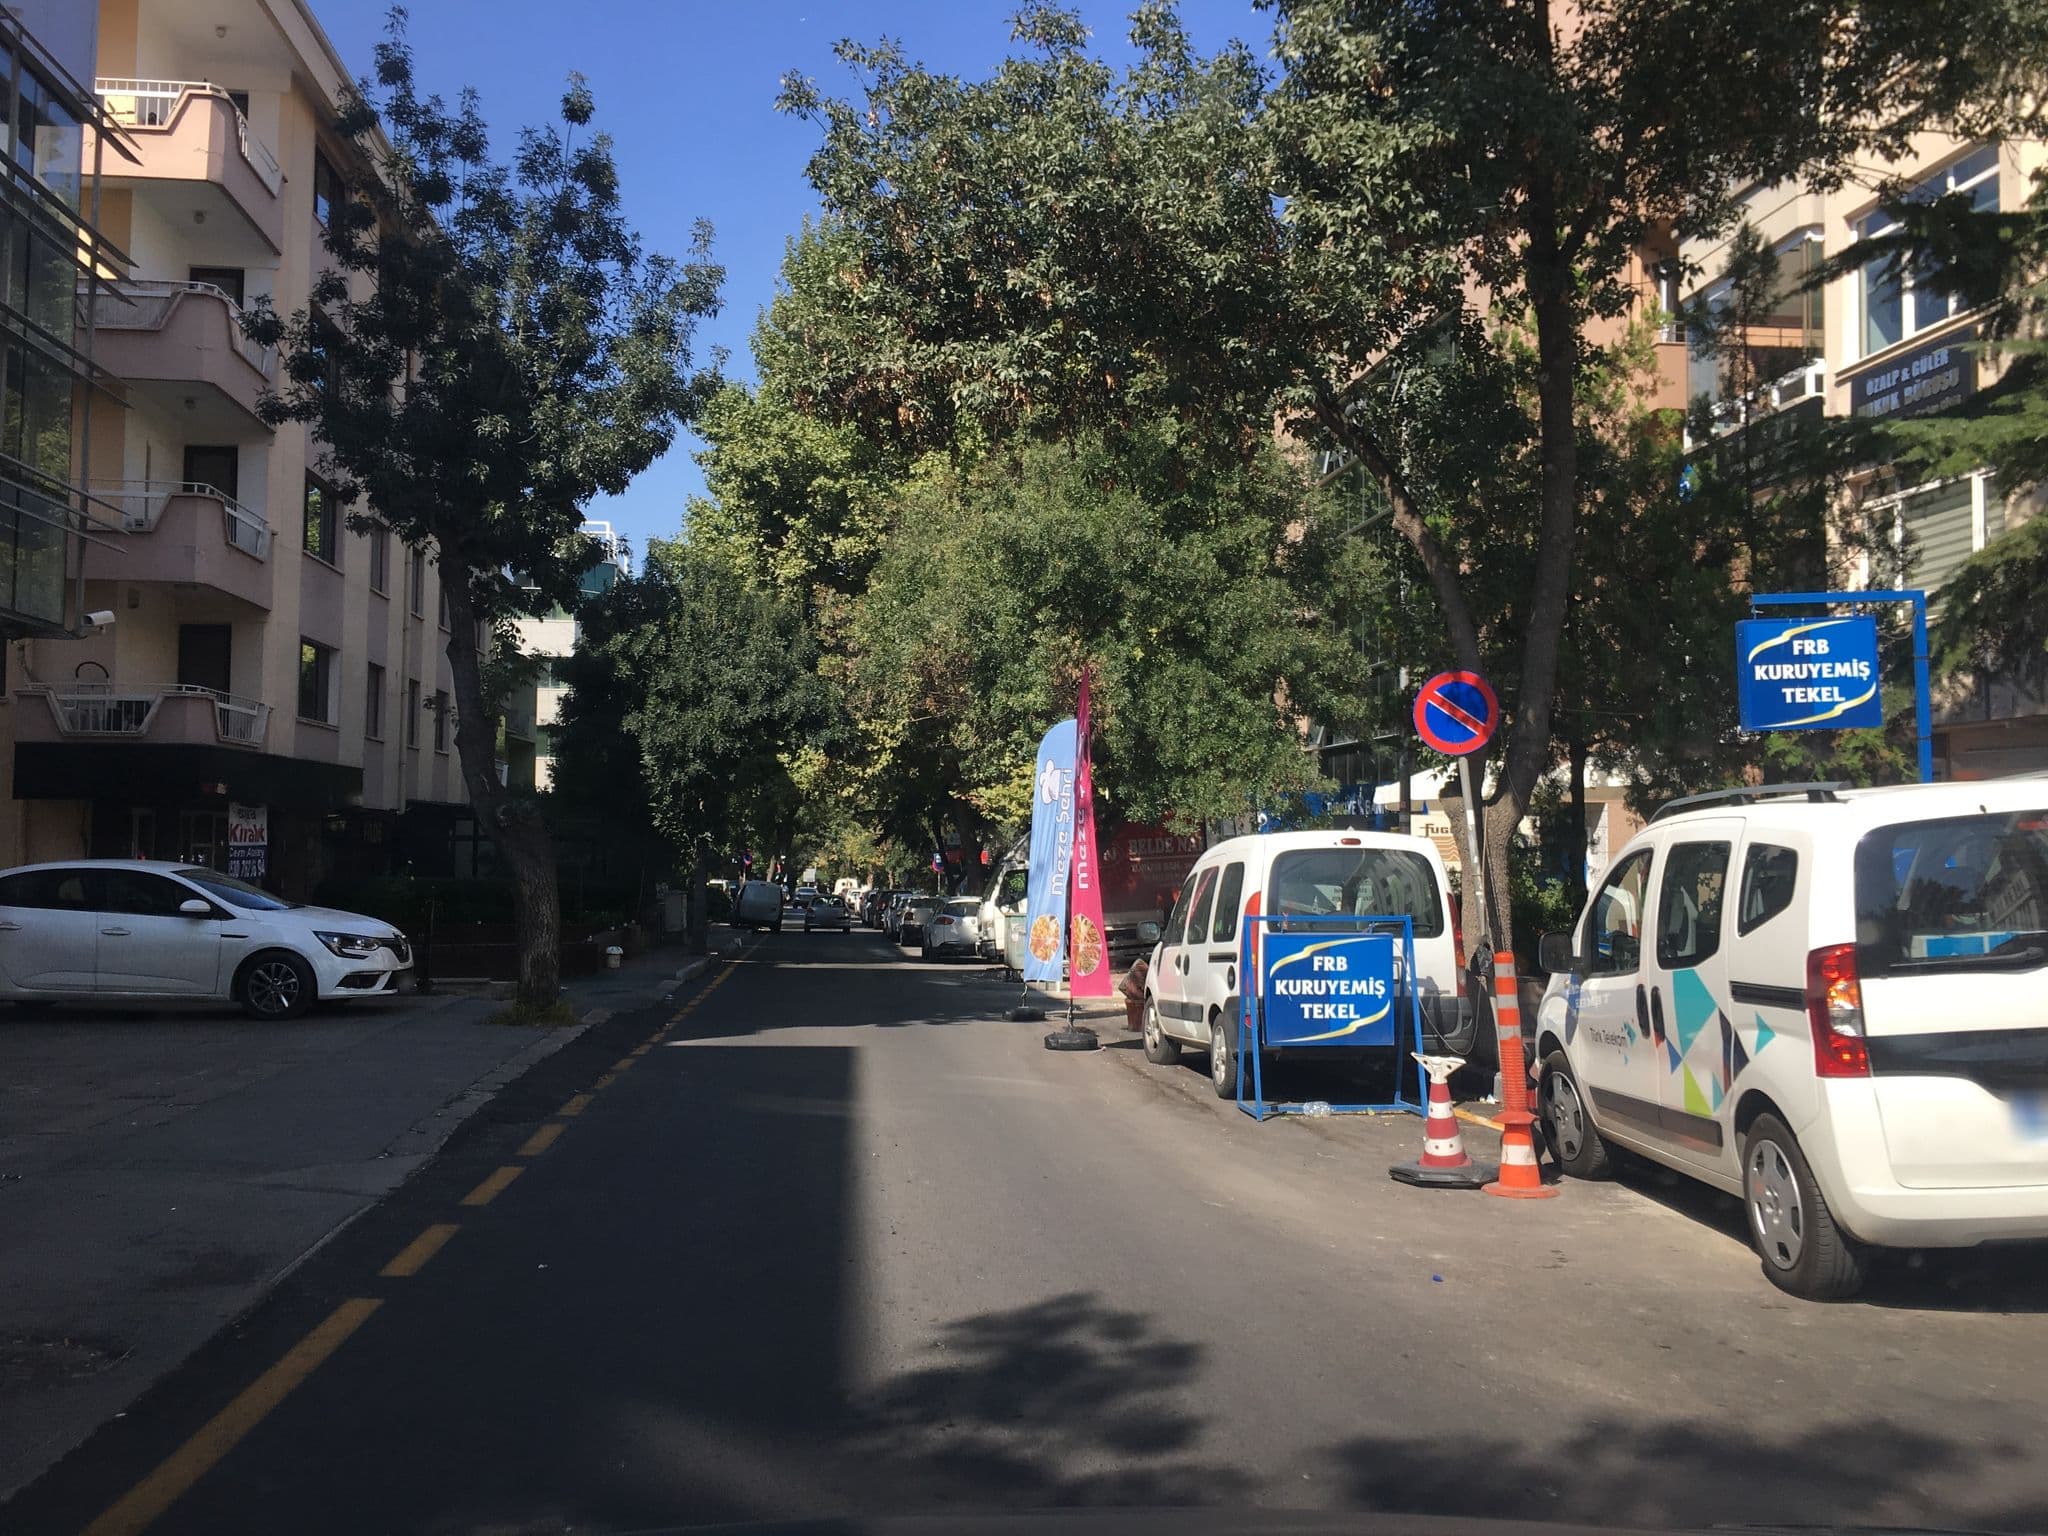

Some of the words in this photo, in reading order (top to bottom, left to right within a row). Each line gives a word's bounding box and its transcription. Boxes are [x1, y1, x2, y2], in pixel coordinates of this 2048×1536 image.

[1792, 638, 1831, 656] FRB
[1754, 658, 1871, 681] KURUYEMİŞ
[1781, 686, 1846, 704] TEKEL
[1313, 955, 1348, 972] FRB
[1275, 977, 1386, 999] KURUYEMİŞ
[1301, 1003, 1360, 1019] TEKEL
